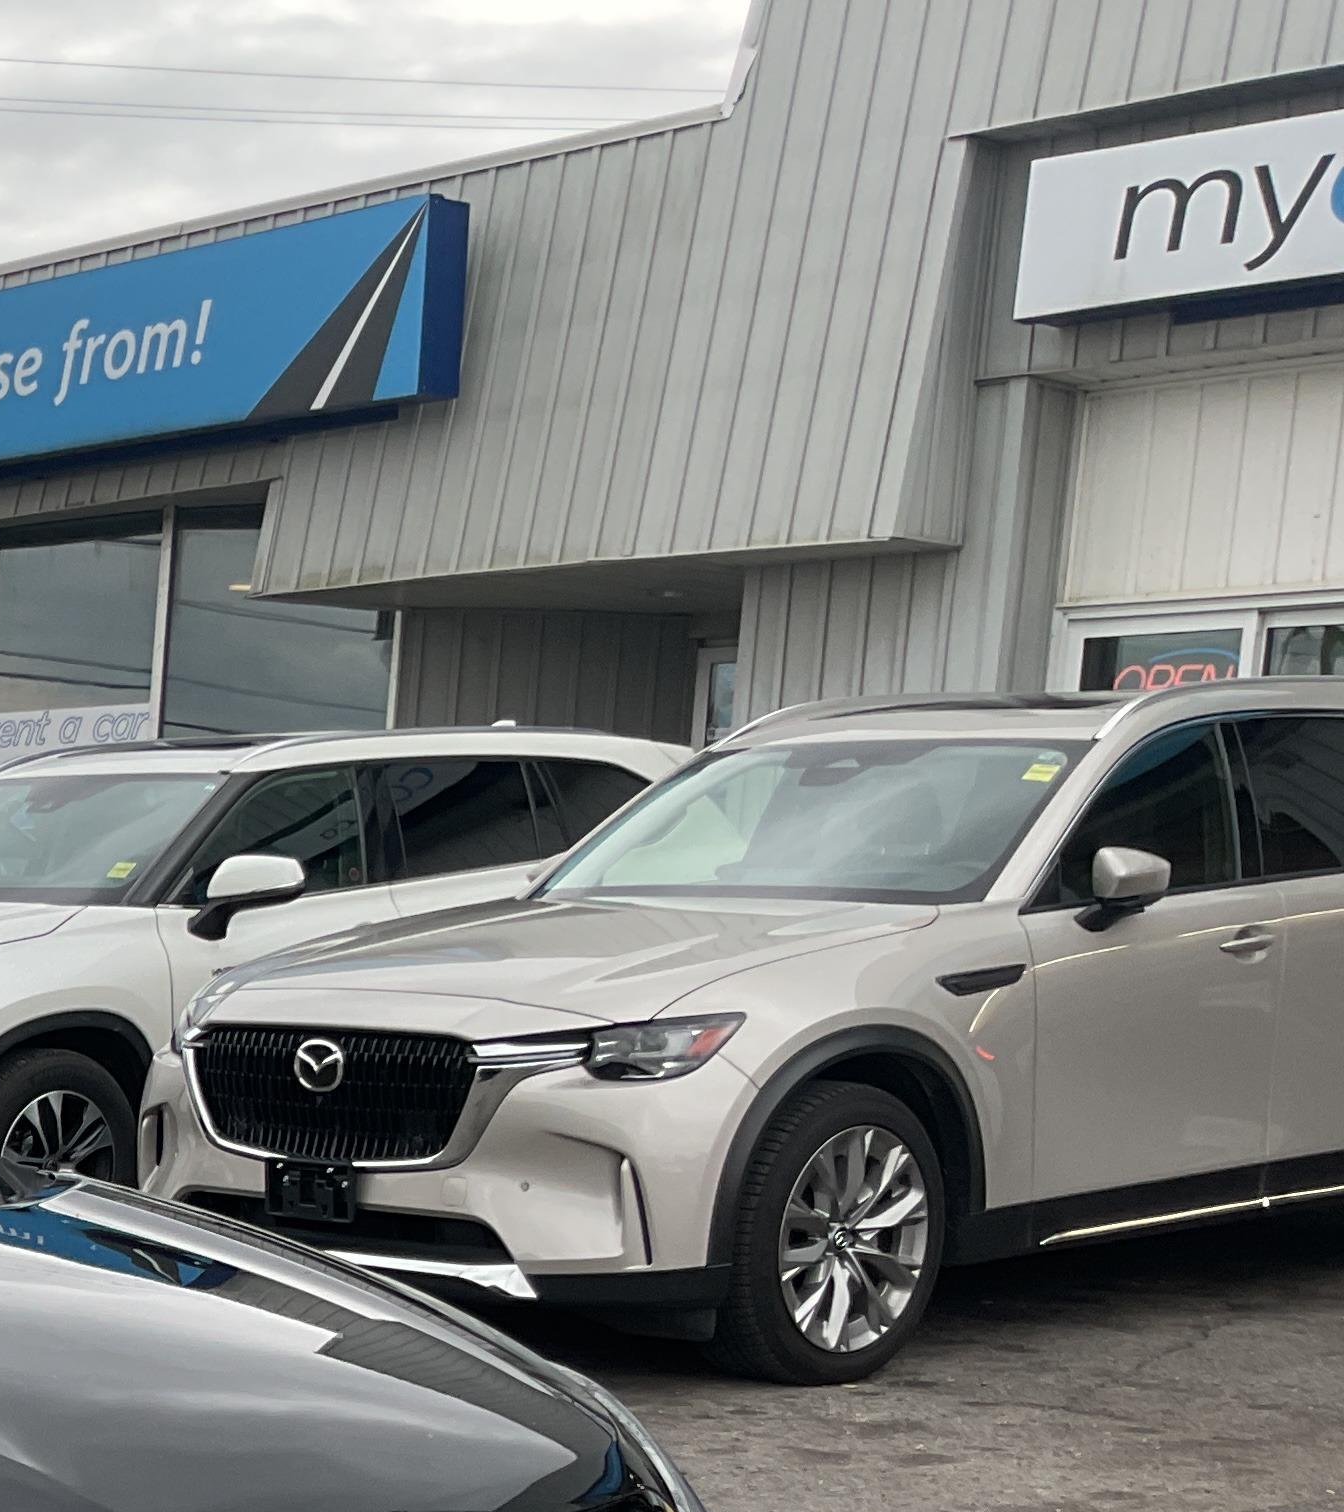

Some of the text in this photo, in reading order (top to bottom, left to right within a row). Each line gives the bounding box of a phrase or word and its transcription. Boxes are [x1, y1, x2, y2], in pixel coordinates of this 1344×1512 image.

[1113, 153, 1344, 271] my
[54, 299, 212, 407] from!
[59, 716, 83, 744] a
[93, 712, 150, 743] car
